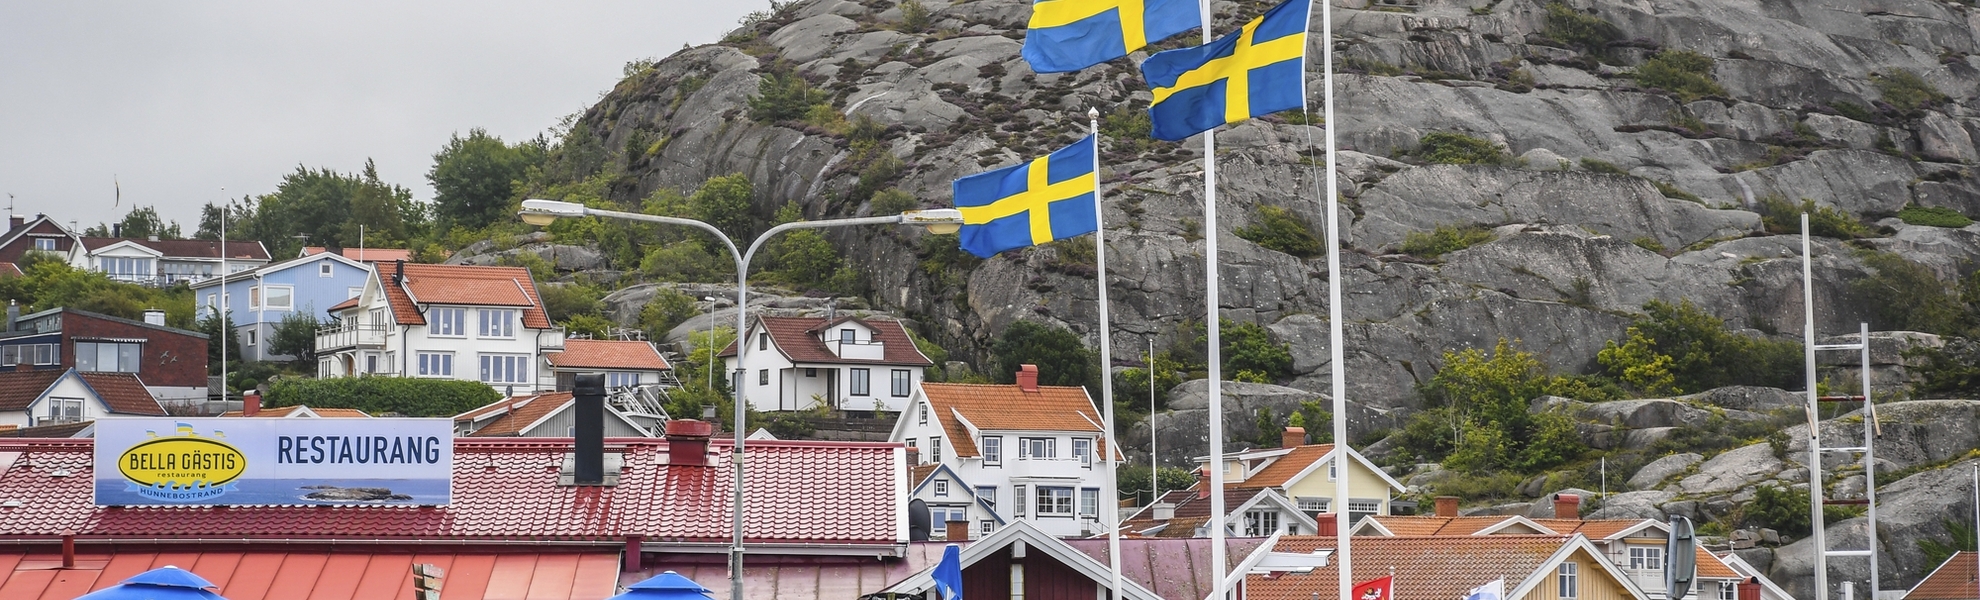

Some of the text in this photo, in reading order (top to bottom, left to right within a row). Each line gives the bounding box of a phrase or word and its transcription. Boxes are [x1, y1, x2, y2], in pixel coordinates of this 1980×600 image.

[130, 450, 235, 470] BELLA GÄSTIS
[278, 436, 439, 464] RESTAURANG
[140, 487, 223, 499] HUNNEBOSTRAND
